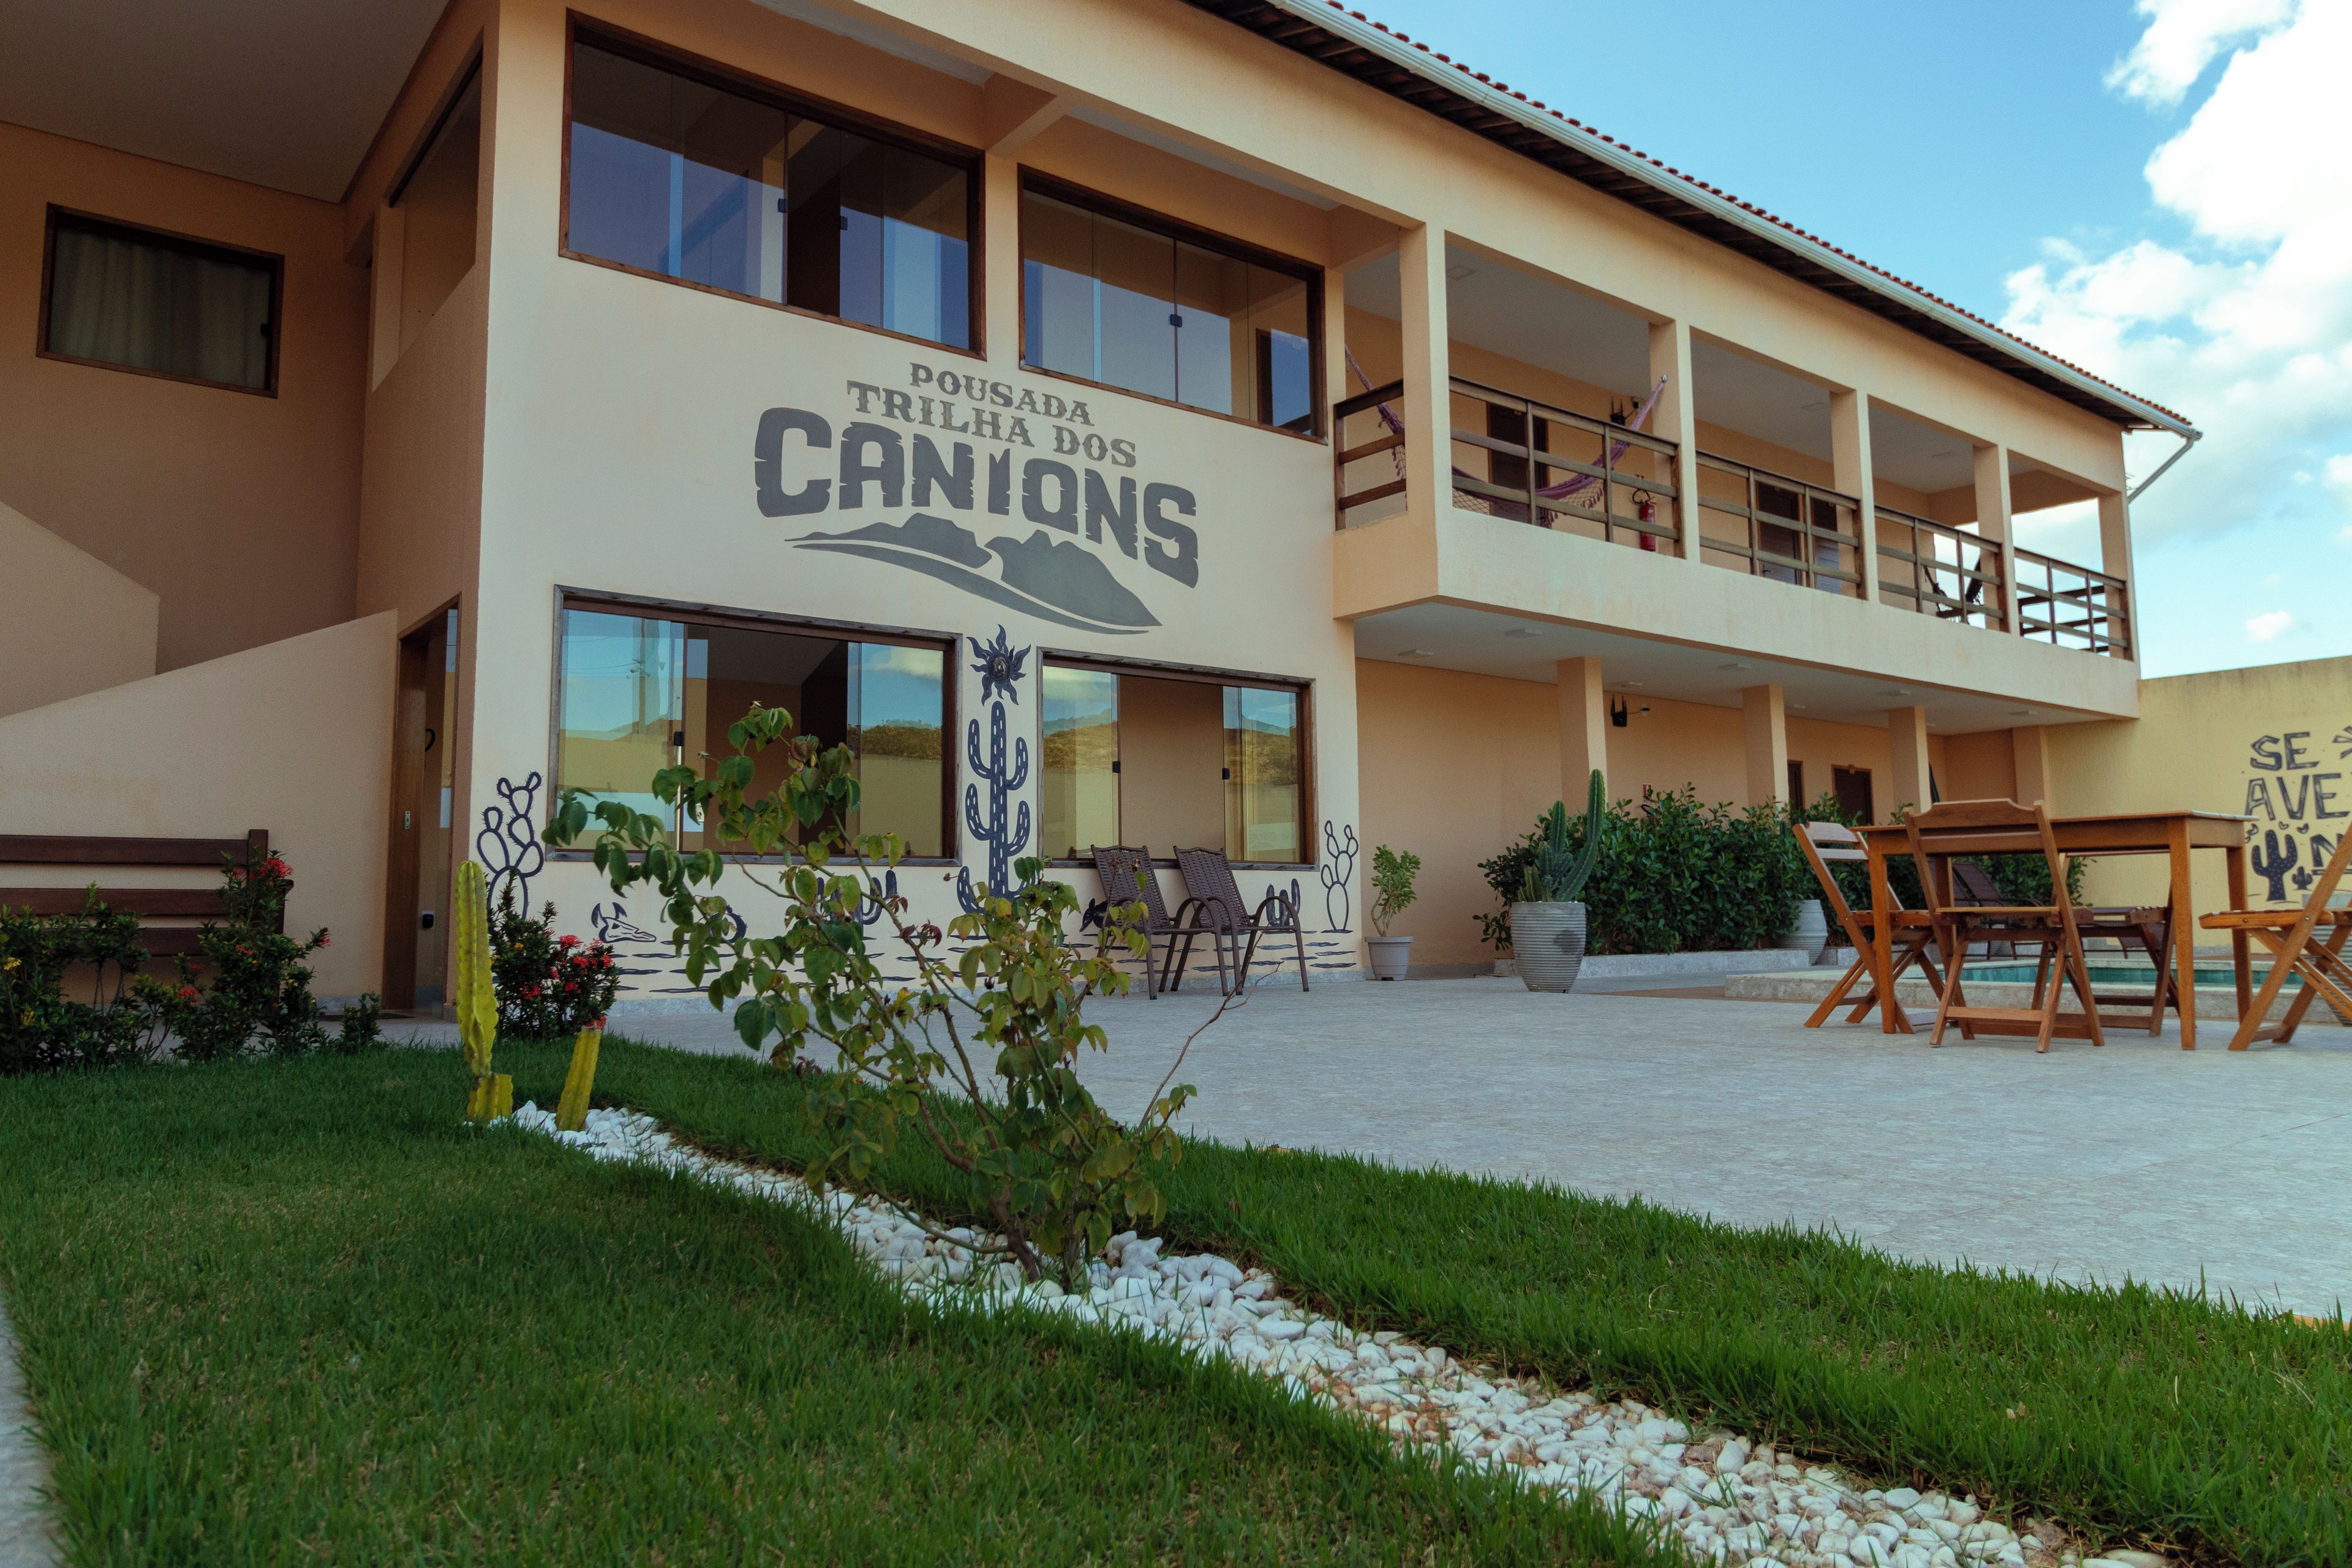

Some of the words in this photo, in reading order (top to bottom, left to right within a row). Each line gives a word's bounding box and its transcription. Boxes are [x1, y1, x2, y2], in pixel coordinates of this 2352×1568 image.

[846, 379, 1035, 448] TRILHA
[1053, 424, 1137, 469] DOS
[910, 362, 1095, 427] POUSADA
[754, 406, 1199, 589] CANIONS
[2249, 731, 2320, 771] SE
[2244, 772, 2352, 821] AVE
